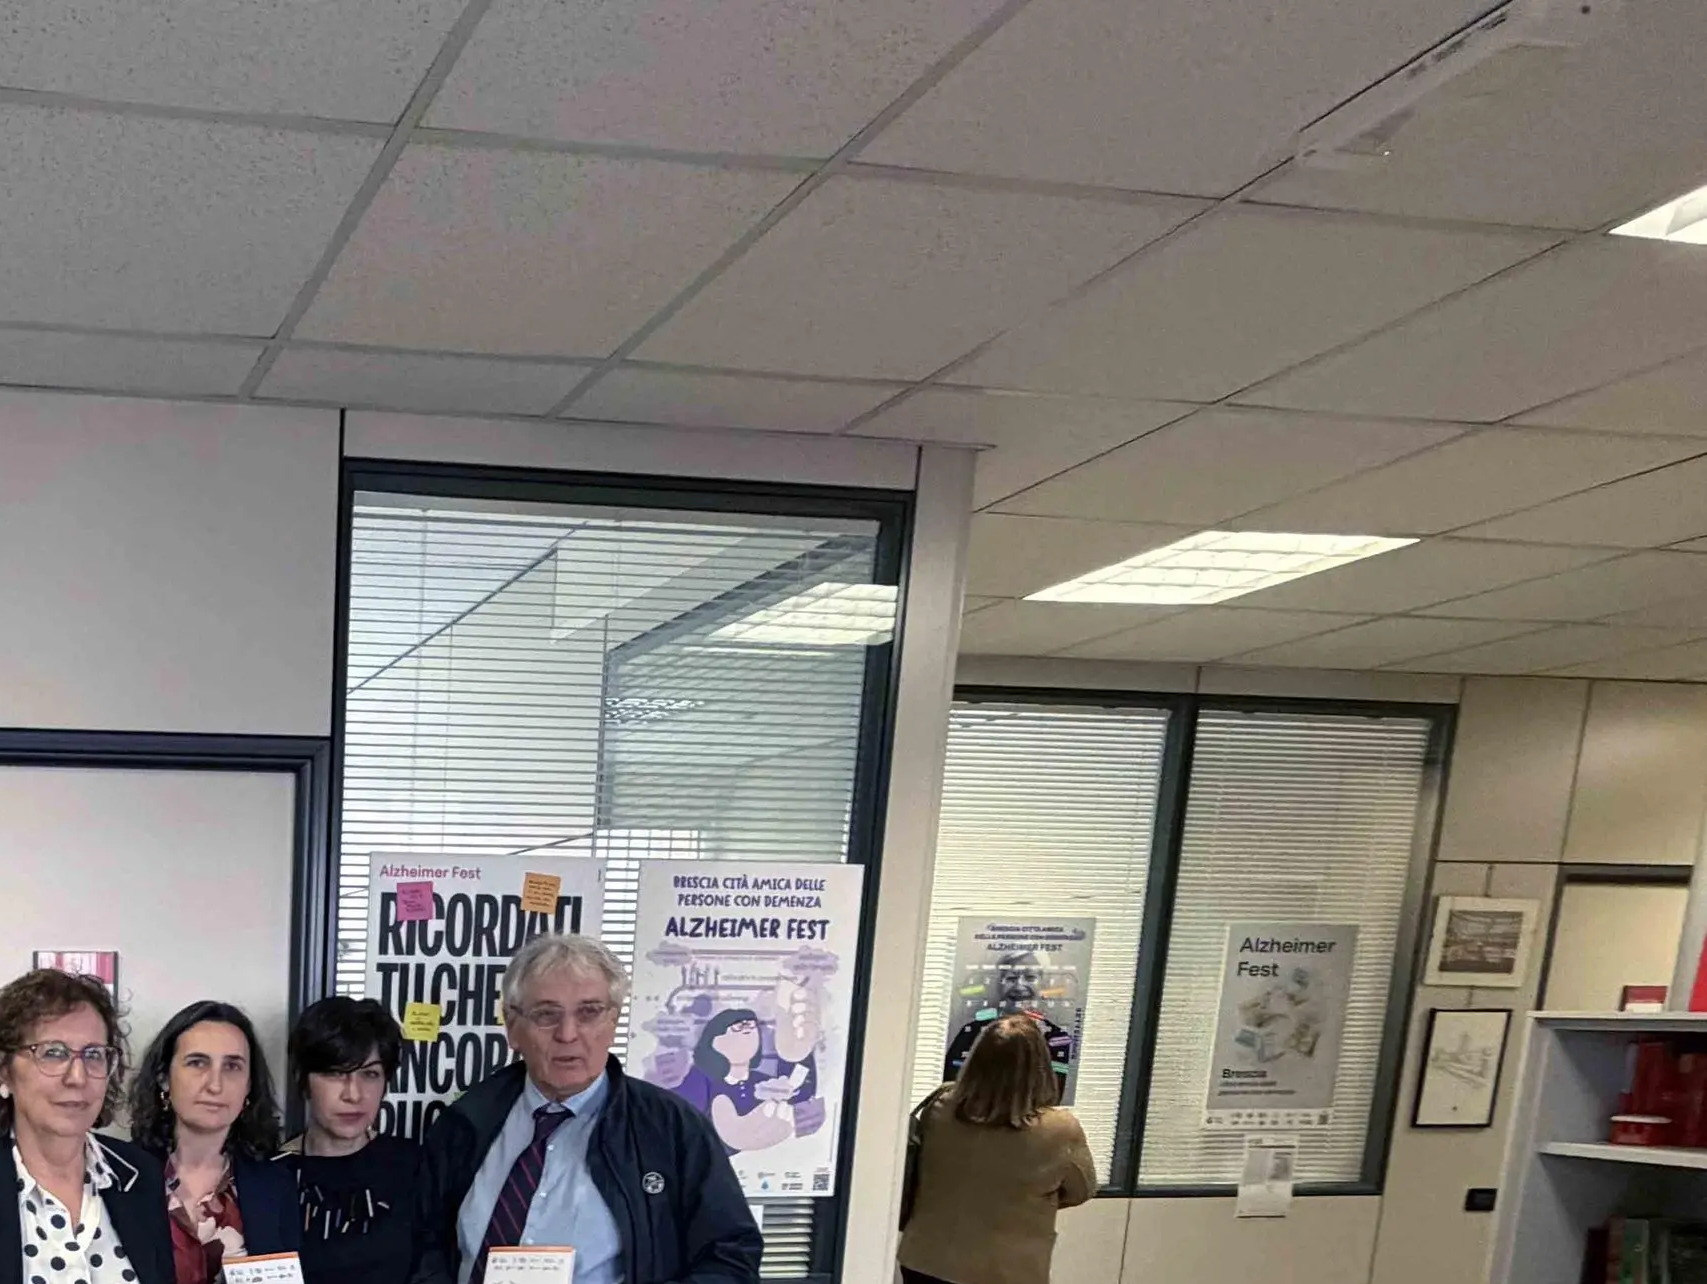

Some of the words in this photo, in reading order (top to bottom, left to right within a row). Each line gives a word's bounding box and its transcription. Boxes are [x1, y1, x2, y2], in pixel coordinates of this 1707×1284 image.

[379, 864, 449, 879] Alzheimer
[452, 866, 481, 879] Fest
[674, 876, 719, 889] BRESCIA
[752, 878, 791, 891] AMICA
[795, 878, 826, 891] DELLE
[678, 894, 731, 907] PERSONE
[734, 895, 760, 907] CON
[764, 895, 821, 908] DEMENZA
[665, 916, 781, 939] ALZHEIMER
[787, 918, 831, 940] FEST
[1239, 936, 1337, 954] Alzheimer
[1237, 961, 1280, 977] Fest
